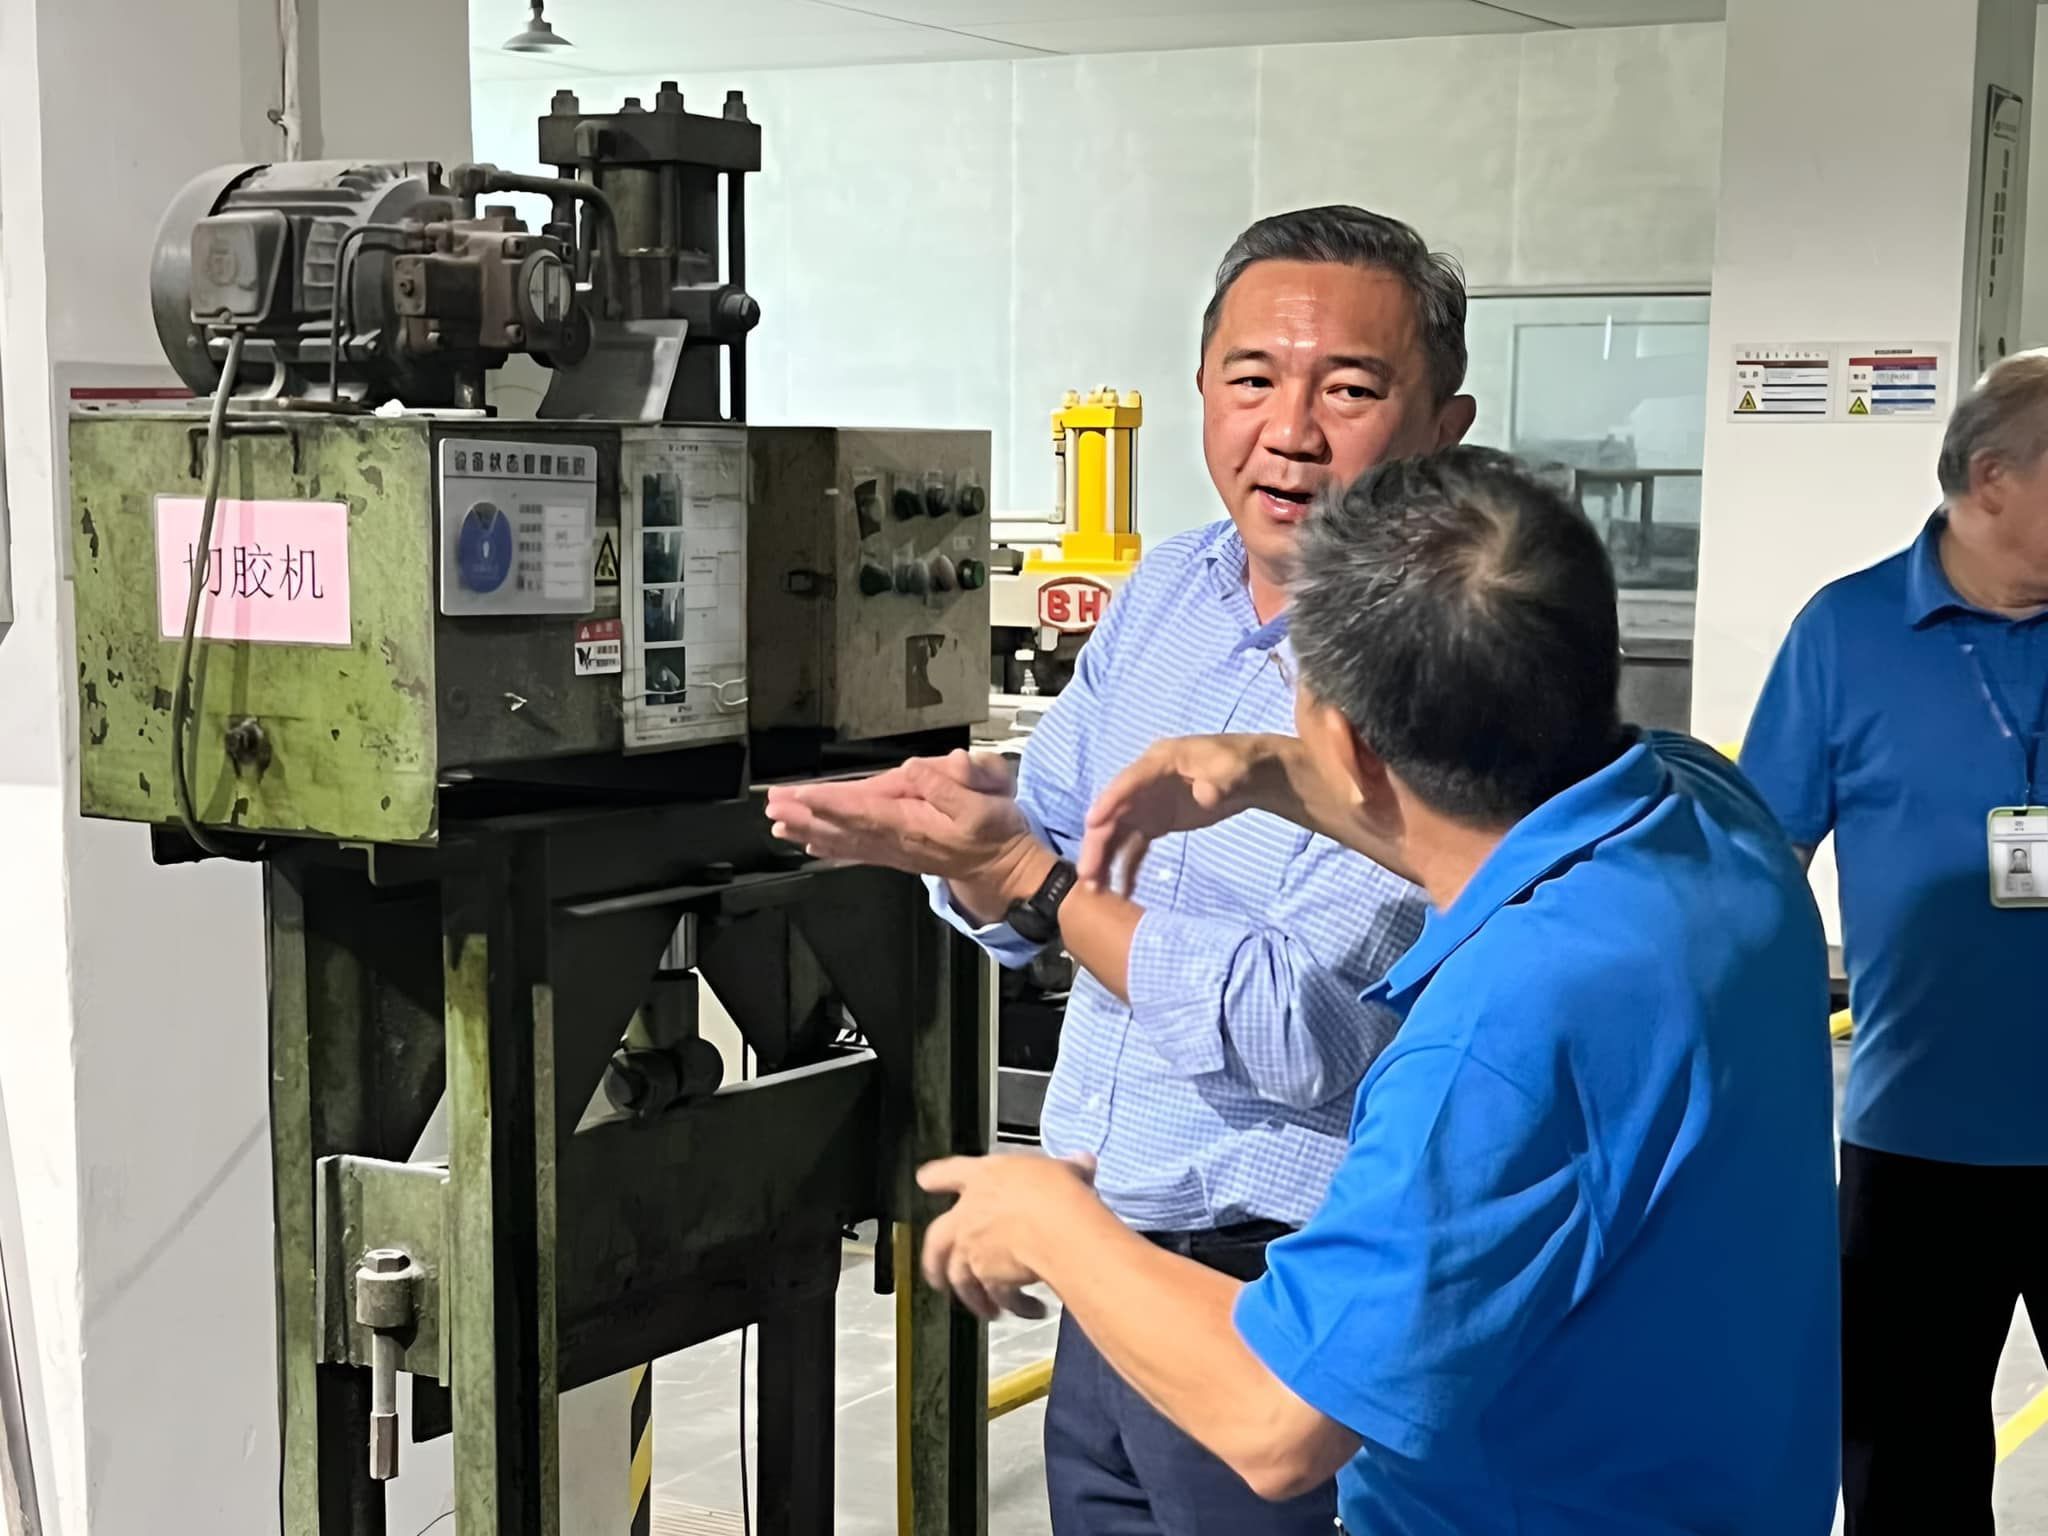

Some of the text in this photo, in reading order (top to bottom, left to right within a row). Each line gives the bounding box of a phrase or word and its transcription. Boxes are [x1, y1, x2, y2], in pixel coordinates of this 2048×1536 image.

[182, 542, 324, 601] 切胶机
[1047, 589, 1101, 623] BH
